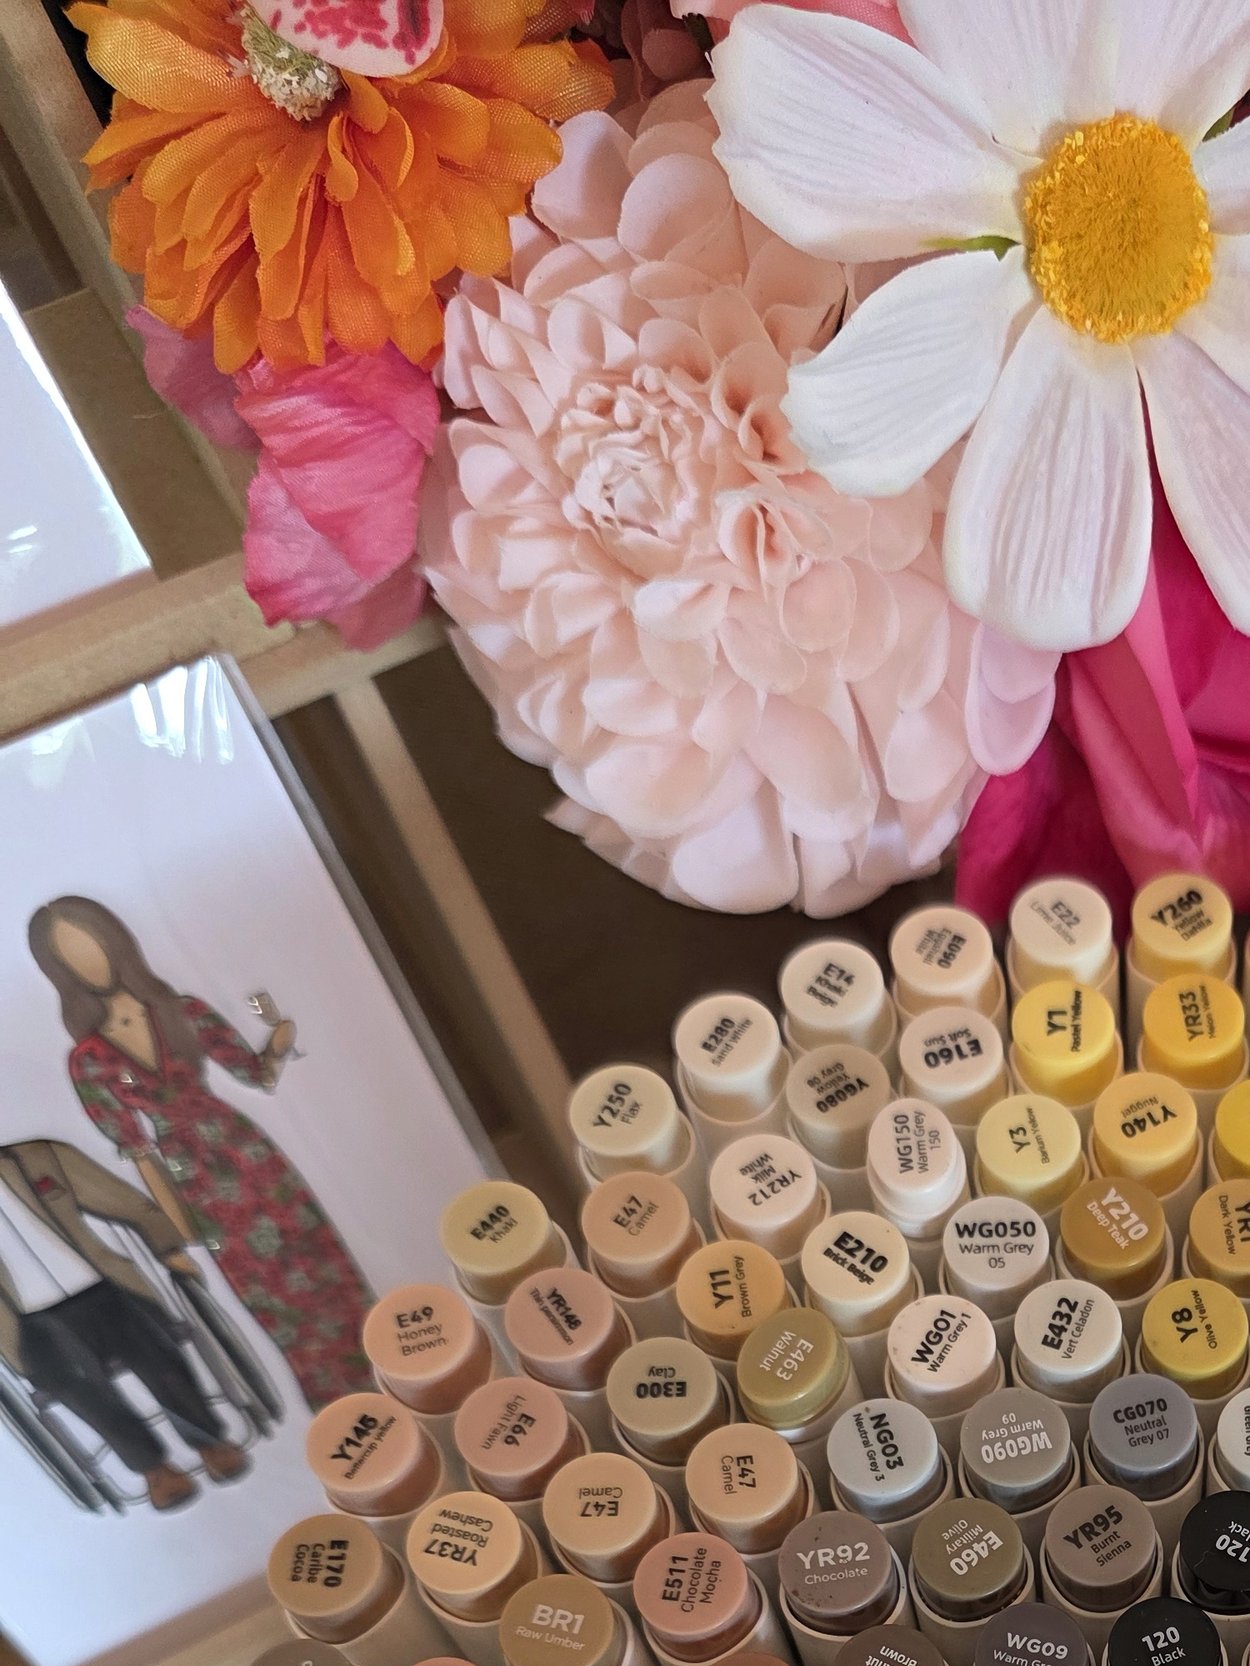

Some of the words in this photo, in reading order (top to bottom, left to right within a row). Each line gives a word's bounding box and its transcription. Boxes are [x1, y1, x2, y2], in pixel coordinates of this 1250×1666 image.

[1047, 1010, 1067, 1036] Y1
[925, 1036, 982, 1068] E160
[593, 1083, 634, 1127] Y250
[620, 1101, 642, 1124] Flax
[913, 1111, 928, 1140] Grey
[1121, 1104, 1177, 1138] Y140
[898, 1115, 911, 1174] WG150
[930, 1130, 941, 1150] 150
[917, 1140, 928, 1173] Warm
[470, 1206, 510, 1242] E440
[613, 1195, 644, 1229] E47
[628, 1201, 660, 1237] Camel
[955, 1221, 1036, 1238] WG050
[829, 1231, 888, 1272] E210
[959, 1243, 999, 1255] Warm
[1003, 1241, 1034, 1256] Grey
[989, 1257, 1005, 1268] 05
[396, 1306, 433, 1328] E49
[1041, 1298, 1081, 1353] E432
[1061, 1337, 1077, 1360] Vert
[1071, 1300, 1094, 1337] Celadon
[397, 1324, 442, 1342] Honey
[400, 1337, 446, 1356] Brown
[648, 1366, 675, 1378] Clay
[636, 1382, 686, 1398] E300
[1113, 1398, 1167, 1427] CG070
[1124, 1415, 1167, 1436] Neutral
[1128, 1432, 1151, 1447] Grey
[1151, 1429, 1170, 1444] 07
[438, 1509, 493, 1532] Cashew
[431, 1523, 488, 1548] Roasted
[323, 1540, 349, 1587] E170
[424, 1539, 477, 1566] YR37
[797, 1542, 870, 1569] YR92
[804, 1566, 869, 1585] Chocolate
[532, 1604, 584, 1634] BR1
[515, 1624, 542, 1641] Raw
[545, 1633, 585, 1650] Umber
[1008, 1633, 1068, 1659] WG09
[1142, 1627, 1180, 1651] 120
[1152, 1647, 1185, 1666] Black
